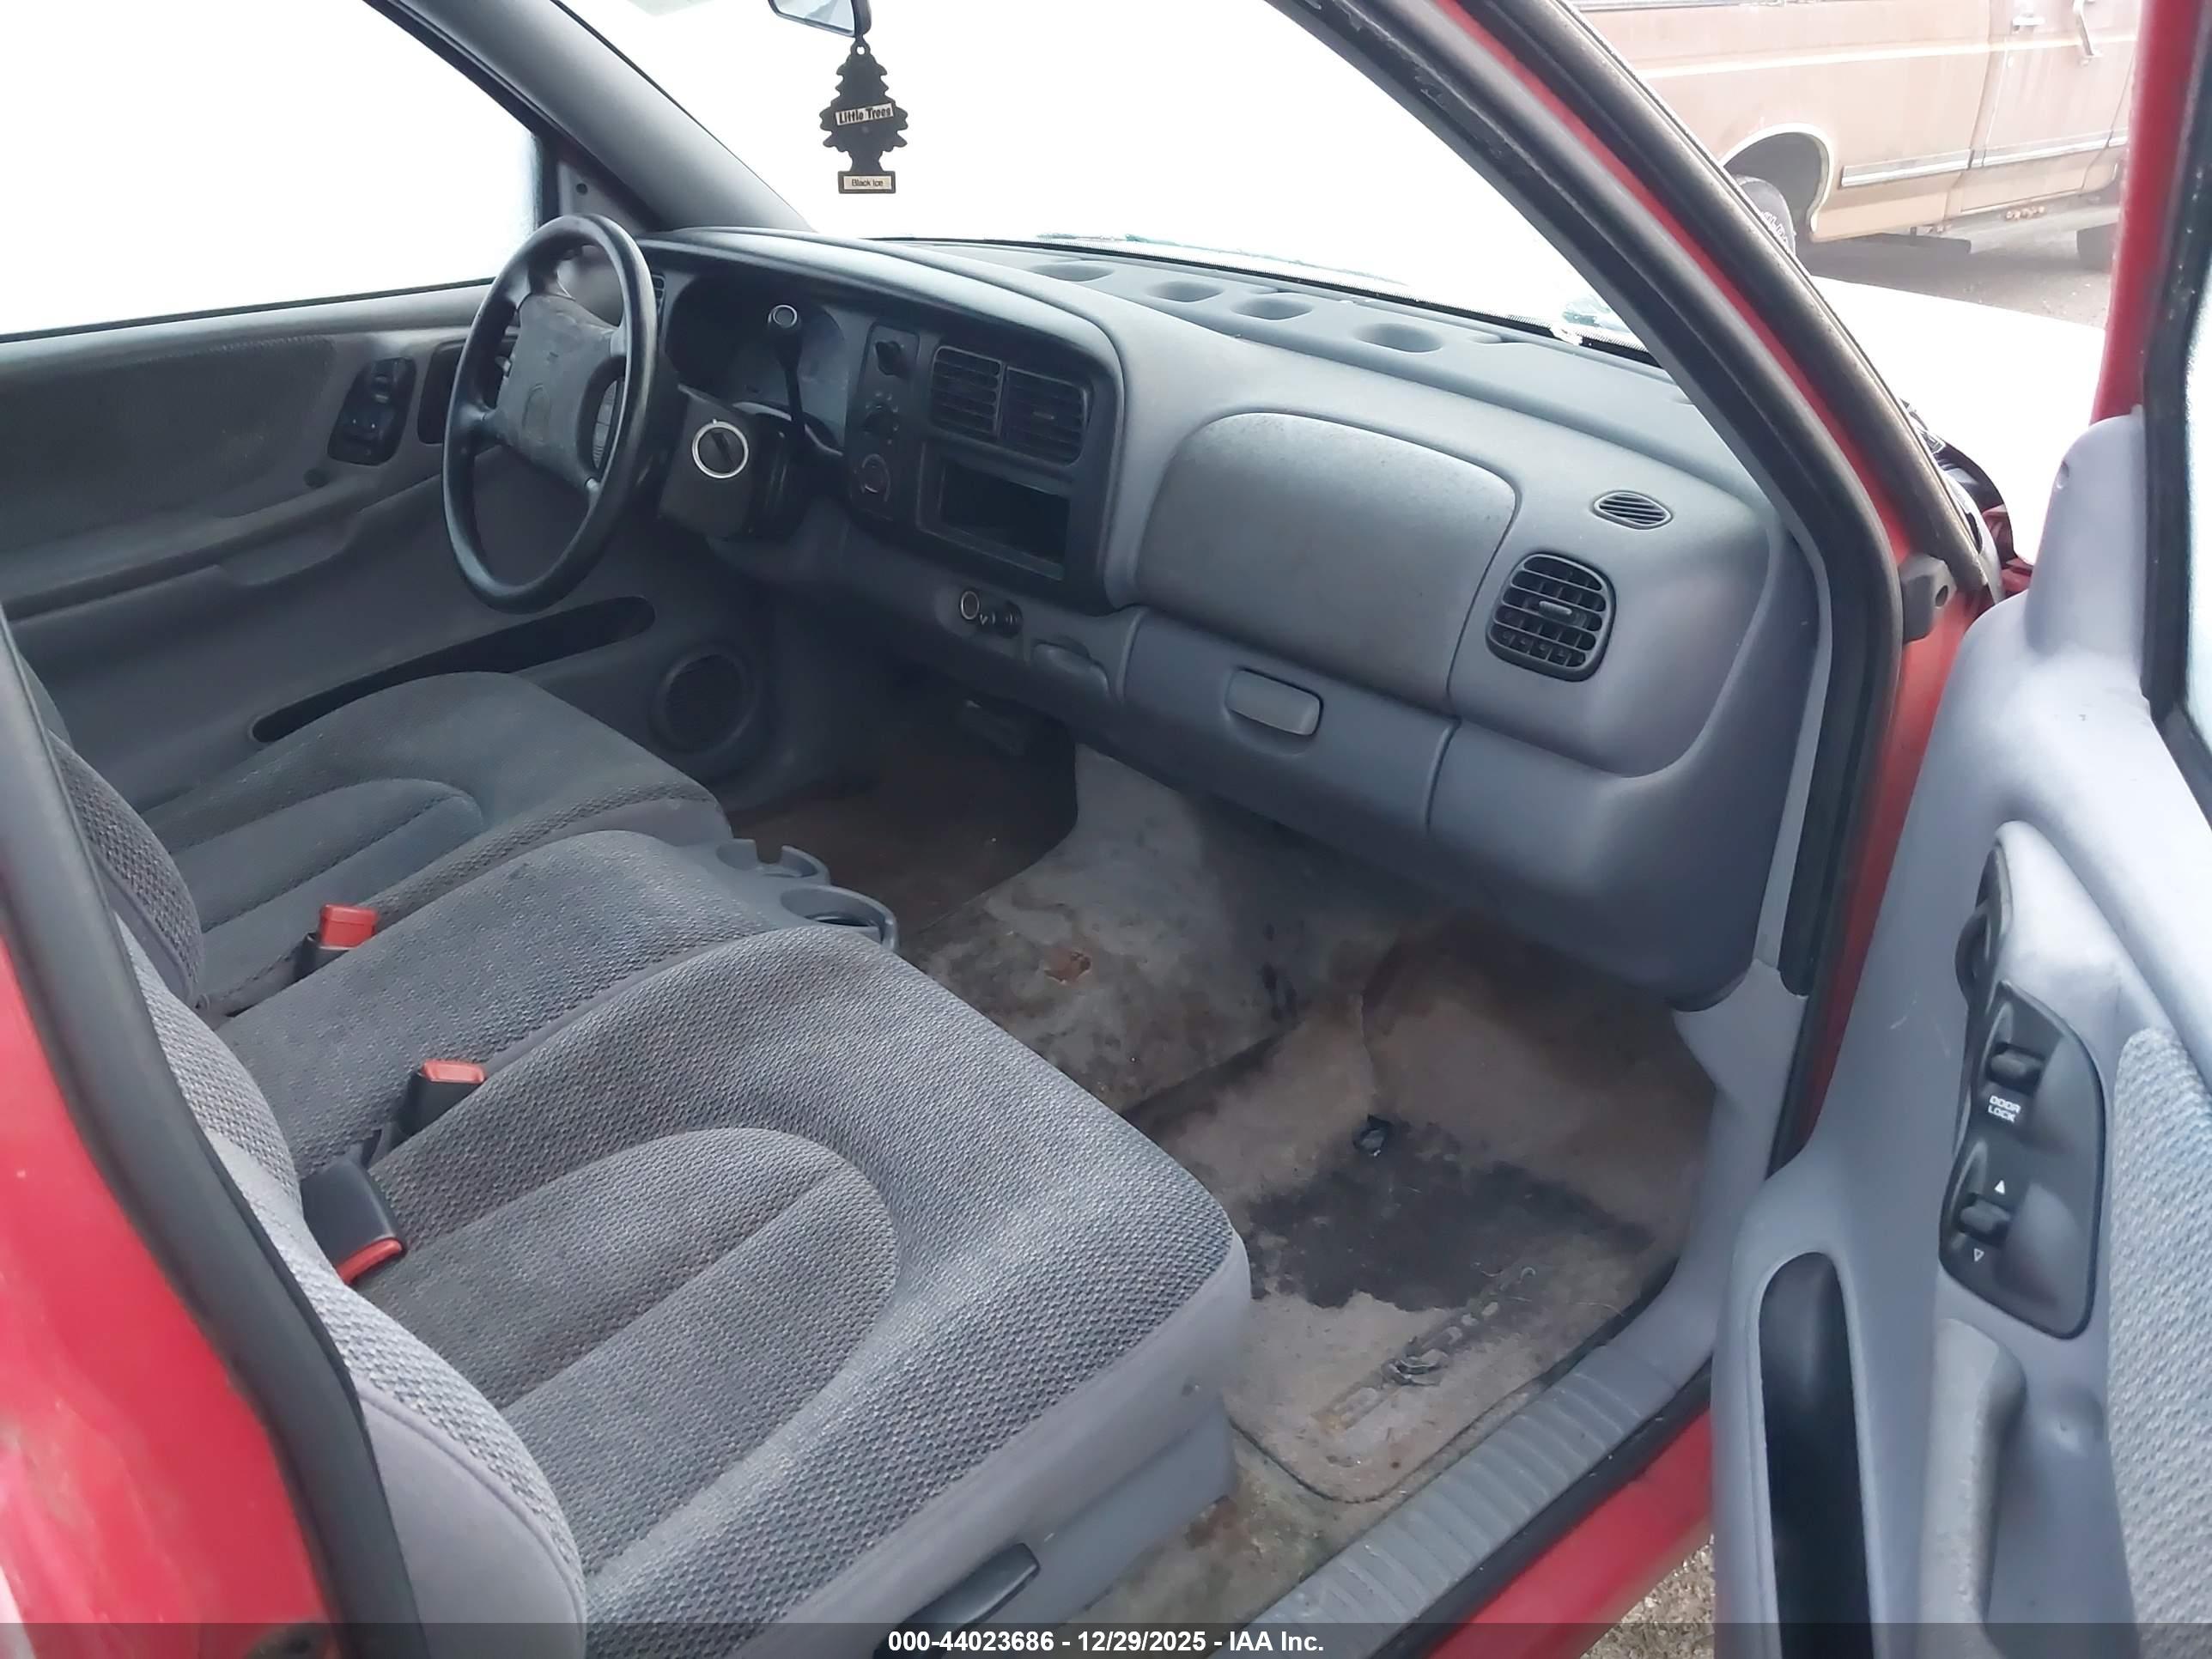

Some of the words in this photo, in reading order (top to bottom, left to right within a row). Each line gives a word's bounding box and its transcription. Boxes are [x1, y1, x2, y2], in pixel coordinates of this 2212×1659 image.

[839, 109, 864, 124] Little
[866, 107, 891, 118] Trees
[1988, 1104, 2015, 1123] LOCK
[1990, 1095, 2021, 1114] DOOR
